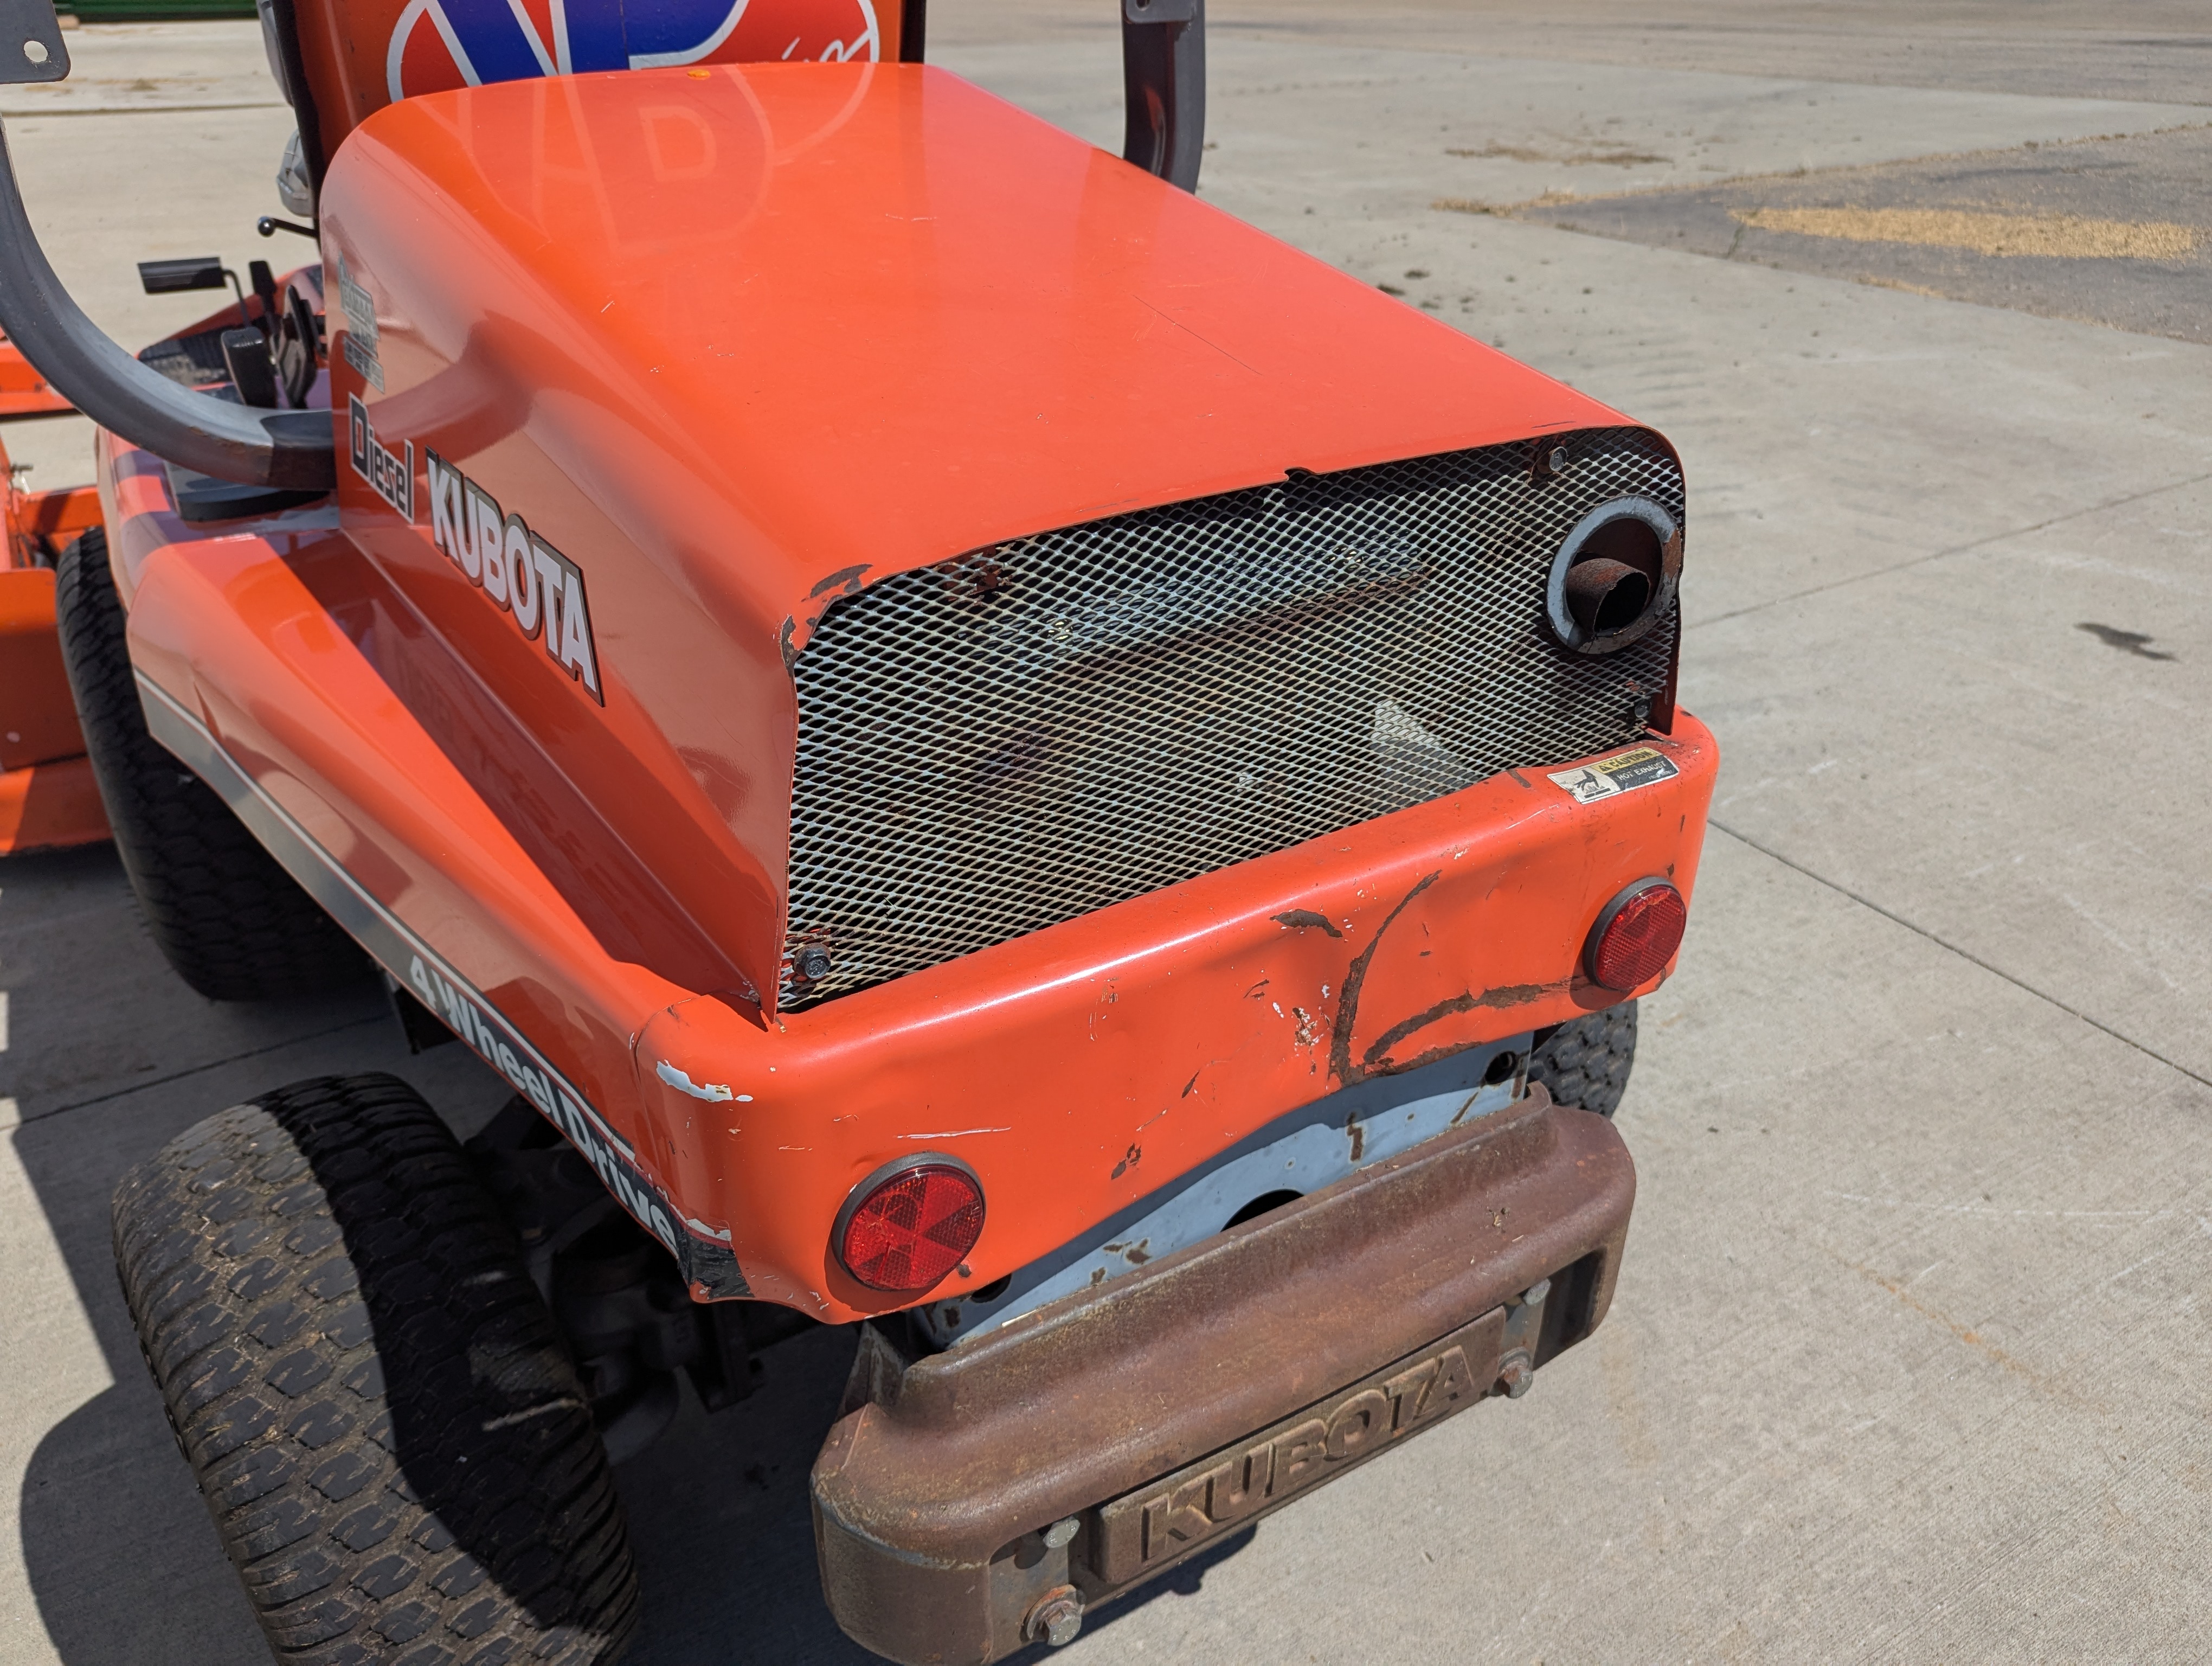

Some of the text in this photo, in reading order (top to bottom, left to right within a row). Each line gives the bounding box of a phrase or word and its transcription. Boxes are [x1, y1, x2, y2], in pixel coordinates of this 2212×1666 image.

[349, 393, 413, 523] Diesel
[427, 453, 599, 696] KUBOTA
[1609, 751, 1653, 767] CAUTION
[1616, 771, 1634, 780] HOT
[1633, 761, 1667, 776] EXHAUST
[410, 954, 679, 1260] 4 Wheel Drive
[1140, 1344, 1476, 1564] KUBOTA
